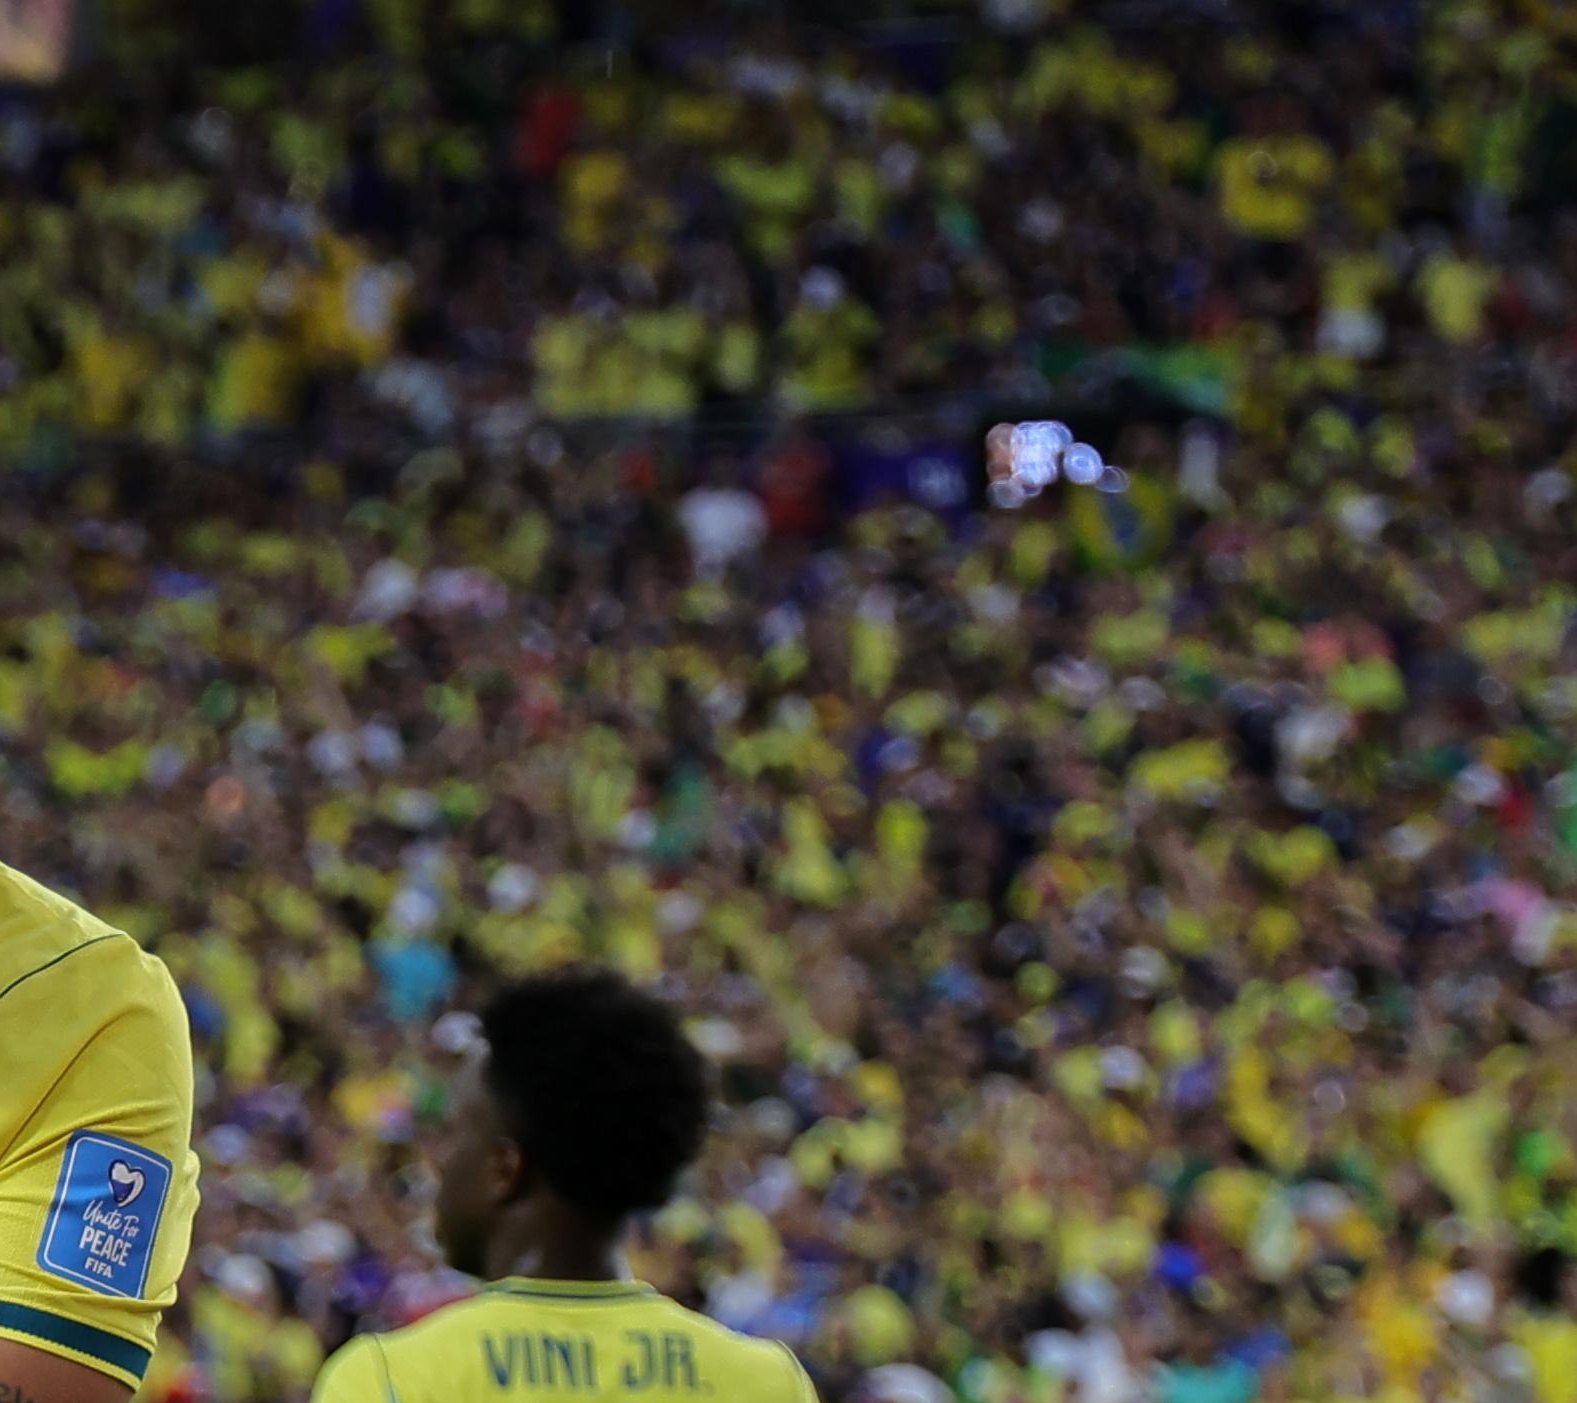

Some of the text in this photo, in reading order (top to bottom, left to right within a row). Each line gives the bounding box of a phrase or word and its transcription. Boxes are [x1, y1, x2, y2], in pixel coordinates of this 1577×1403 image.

[82, 1199, 140, 1238] Unite For
[79, 1225, 132, 1267] PEACE
[84, 1256, 114, 1279] FIFA
[480, 1330, 598, 1392] VINI
